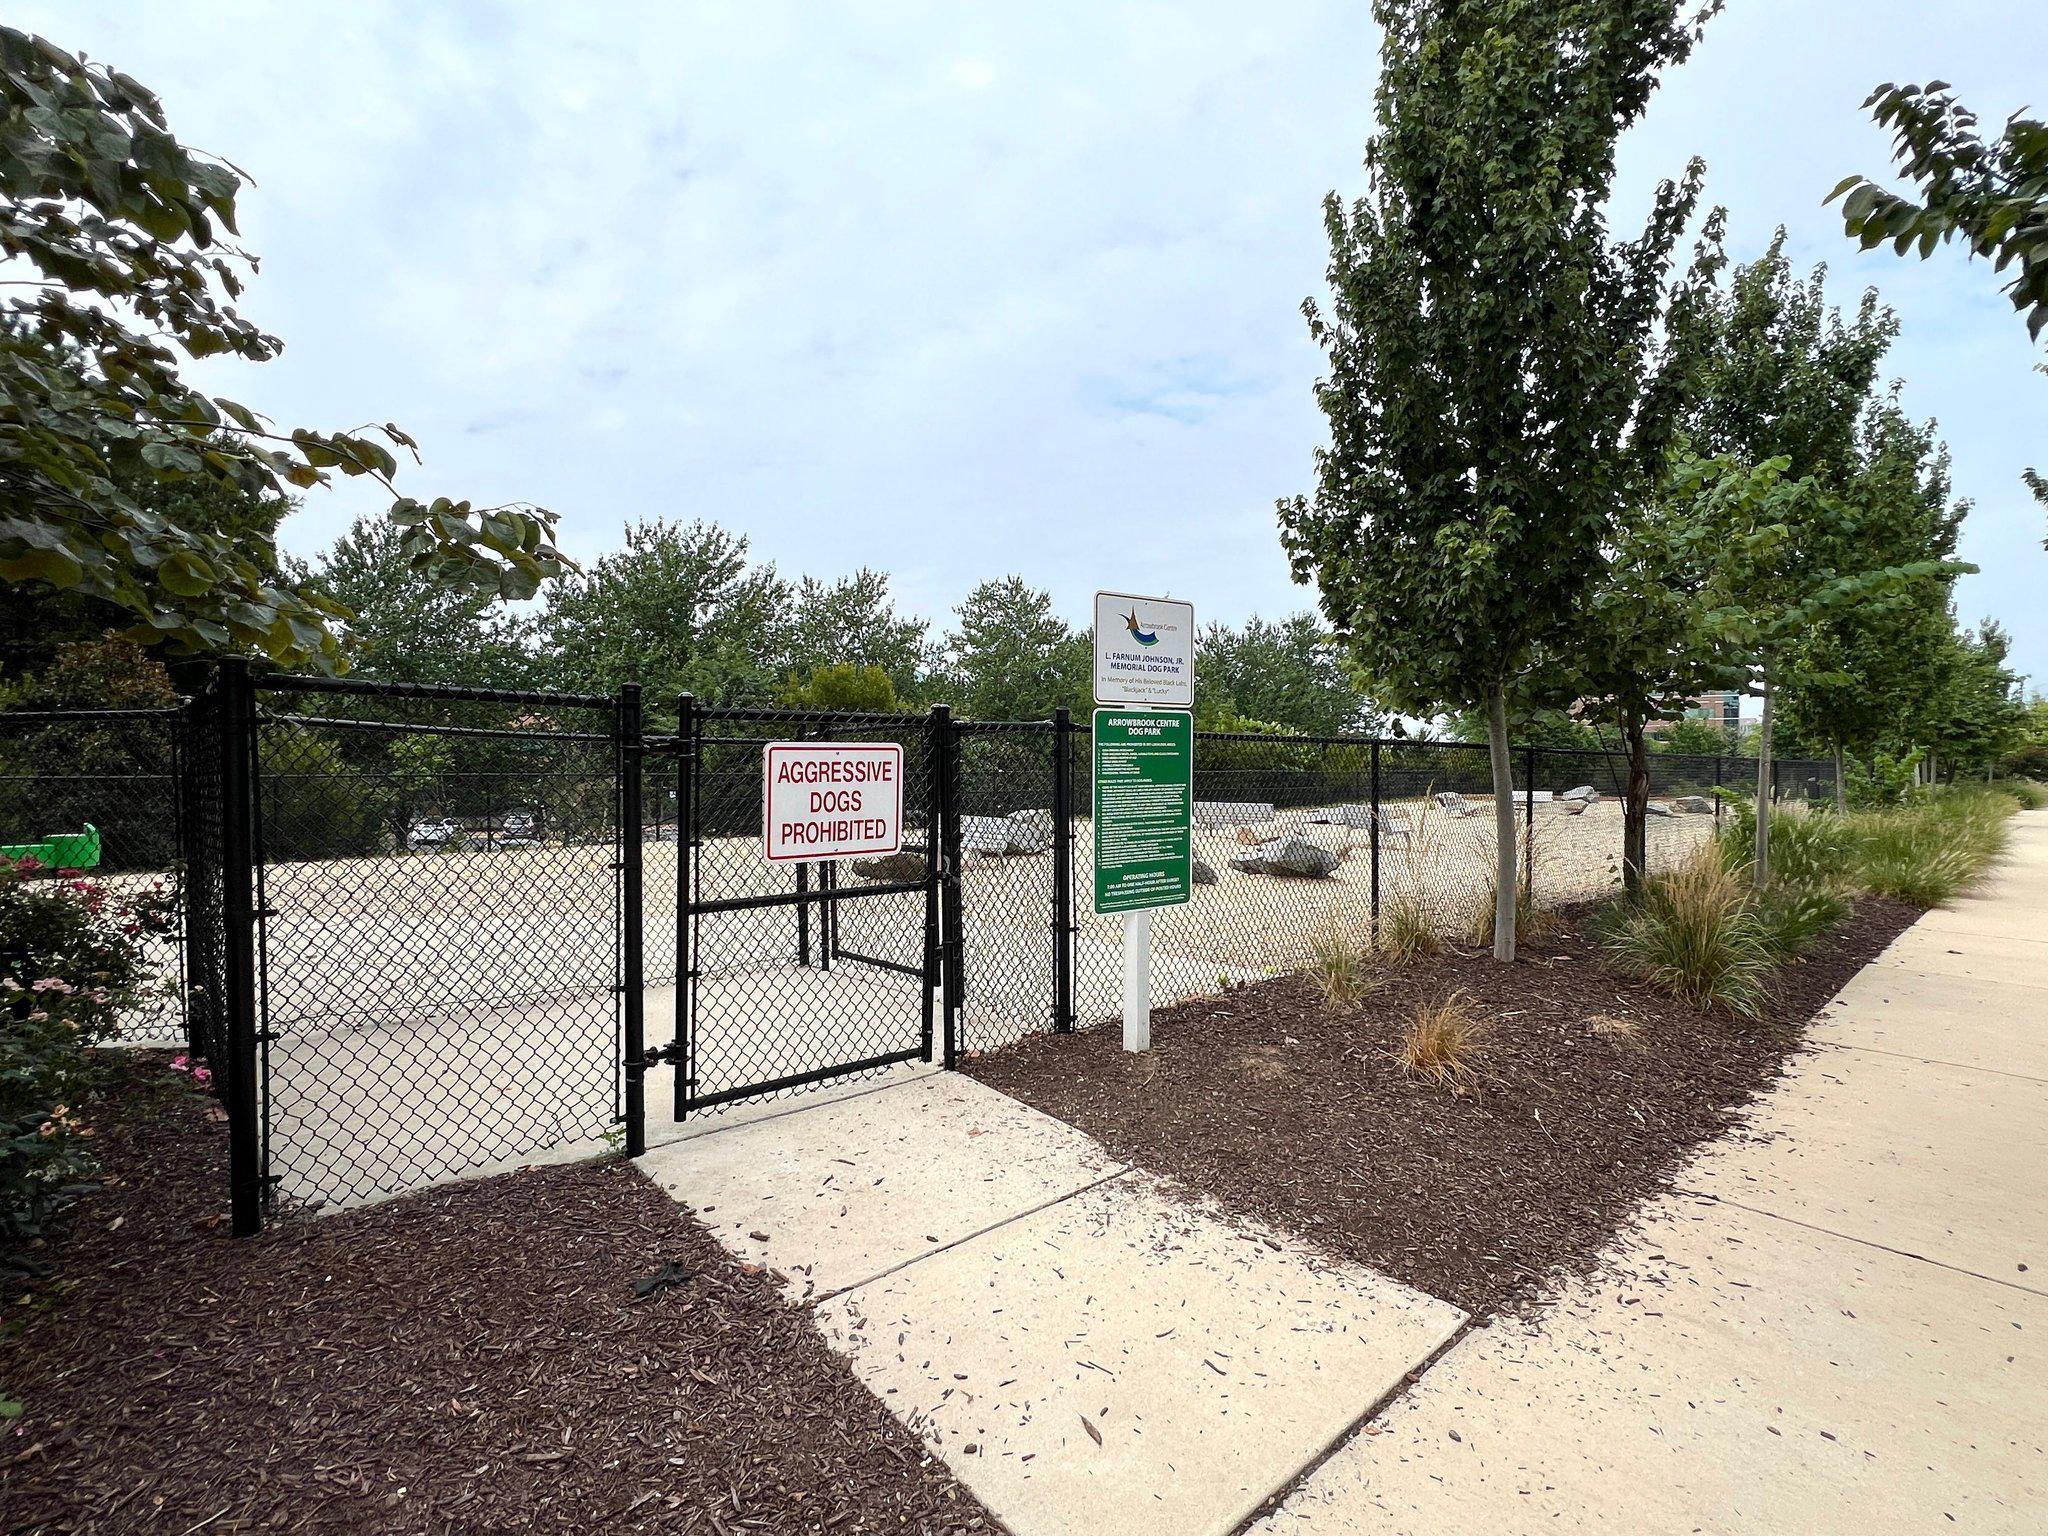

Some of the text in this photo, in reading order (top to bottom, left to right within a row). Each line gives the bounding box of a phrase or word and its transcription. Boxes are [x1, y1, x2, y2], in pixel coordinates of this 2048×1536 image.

[1113, 653, 1140, 661] FARNUM
[1142, 655, 1174, 664] JOHNSON,
[1111, 663, 1146, 671] MEMORIAL
[1108, 718, 1155, 727] ARROWBROOK
[777, 761, 892, 784] AGGRESSIVE
[810, 790, 862, 813] DOGS
[781, 818, 887, 845] PROHIBITED
[1123, 872, 1148, 881] OPERATING
